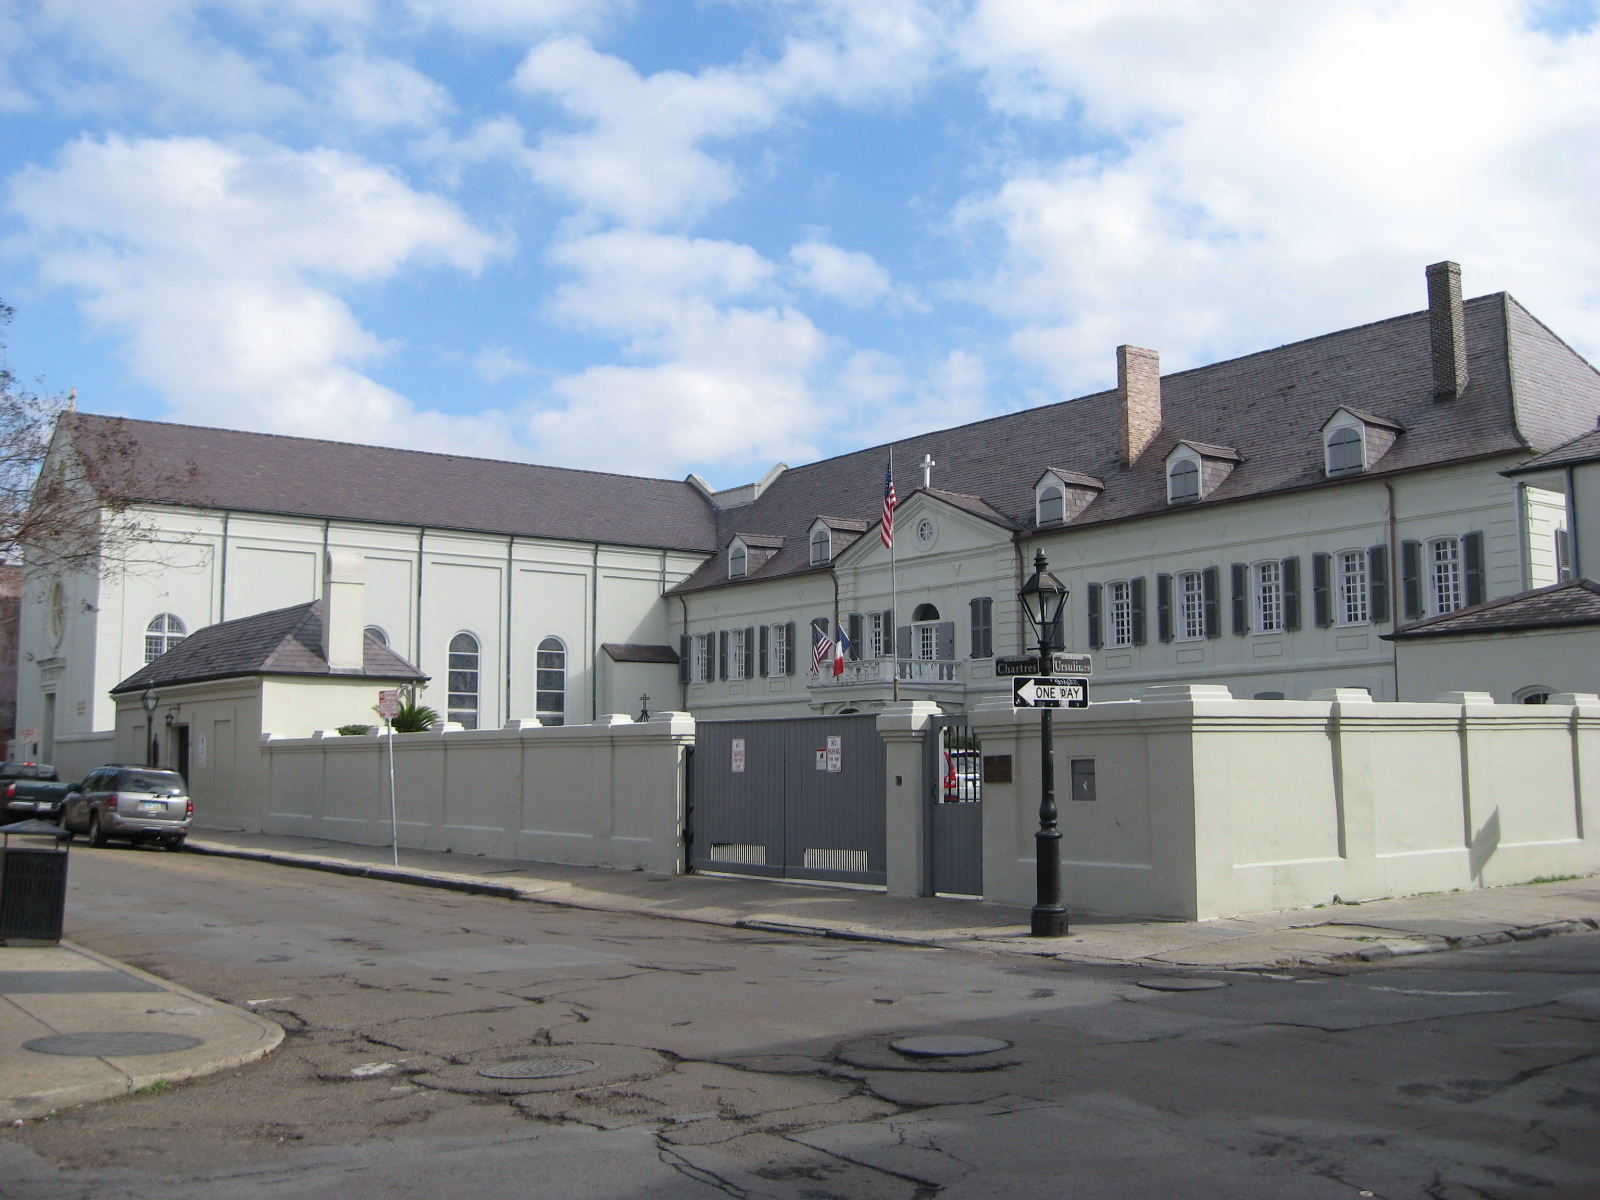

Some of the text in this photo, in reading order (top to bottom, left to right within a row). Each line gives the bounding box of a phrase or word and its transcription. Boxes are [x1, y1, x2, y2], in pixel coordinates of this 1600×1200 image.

[997, 663, 1037, 674] Chartres
[1054, 660, 1090, 672] Ursulines
[1035, 687, 1056, 699] ONE
